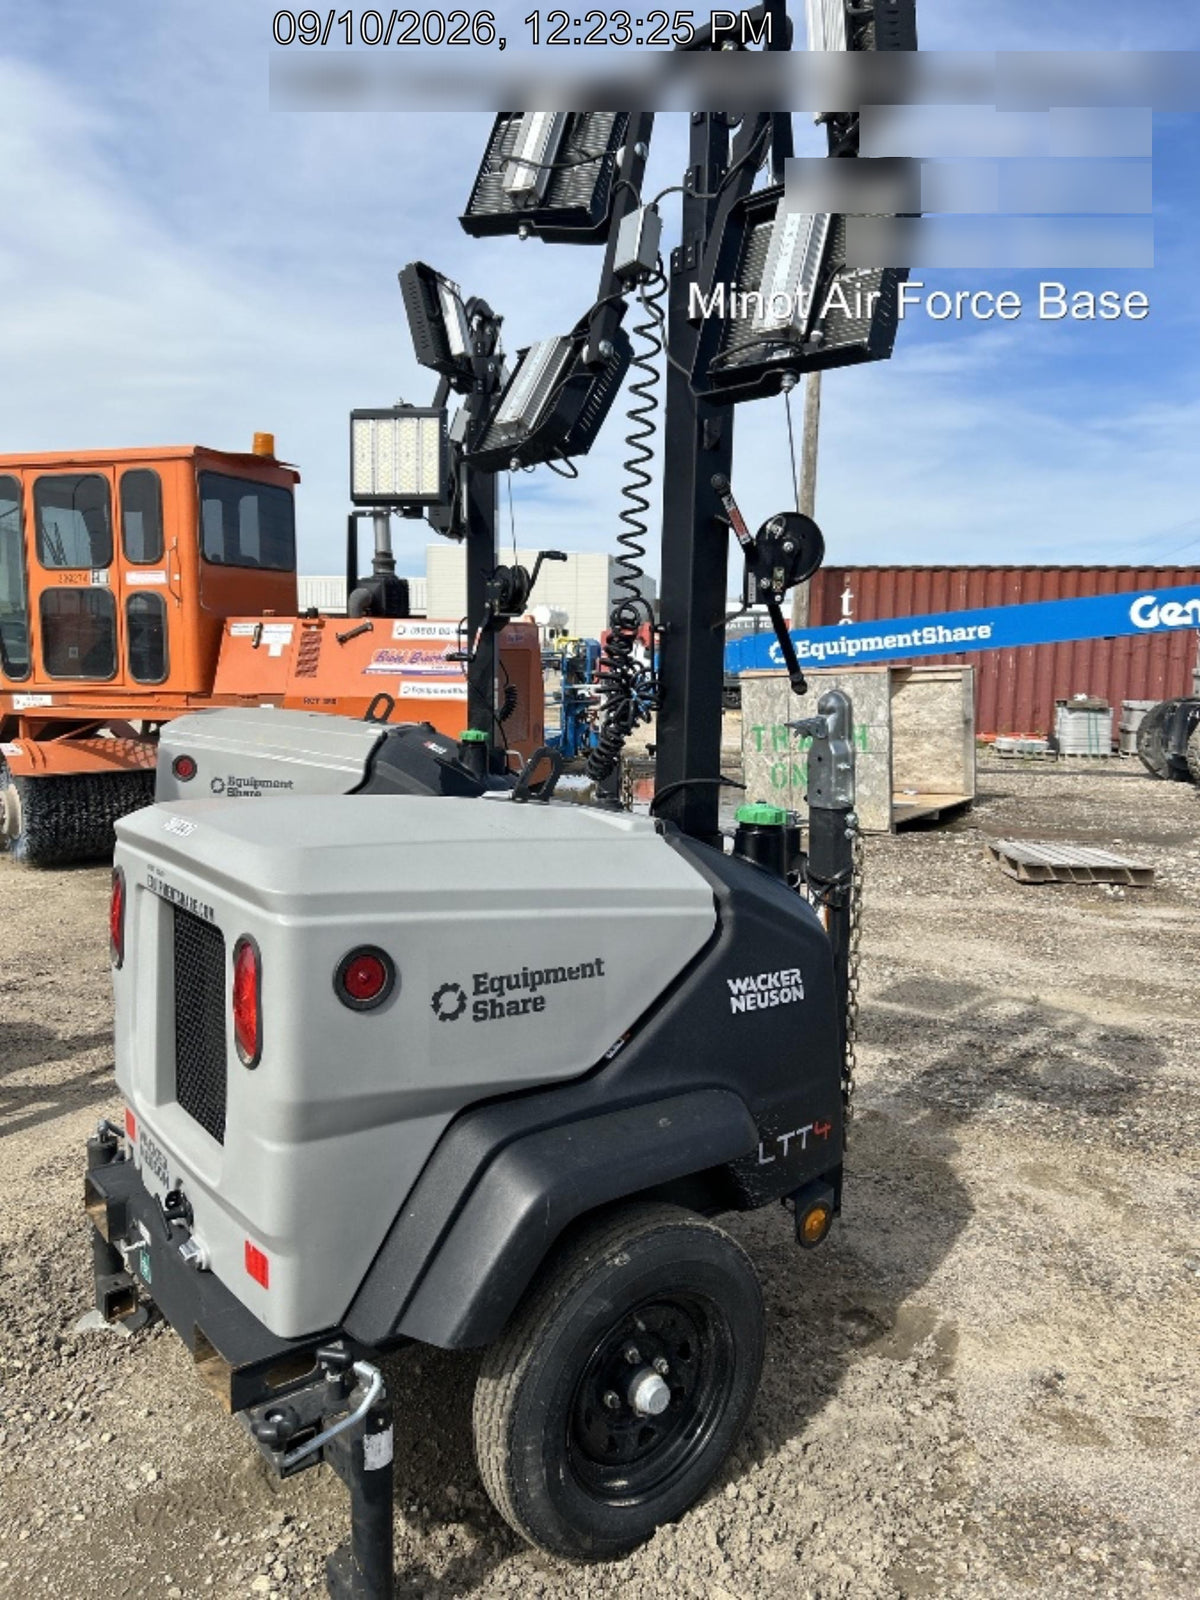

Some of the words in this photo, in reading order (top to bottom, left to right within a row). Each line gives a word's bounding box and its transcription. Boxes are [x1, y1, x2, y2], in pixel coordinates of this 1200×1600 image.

[795, 624, 992, 661] EquipmentShare
[227, 775, 294, 789] Equipment
[227, 787, 262, 797] Share
[472, 957, 605, 997] Equipment
[727, 968, 803, 995] WACKER
[472, 995, 546, 1022] Share
[730, 984, 805, 1015] NEUSON
